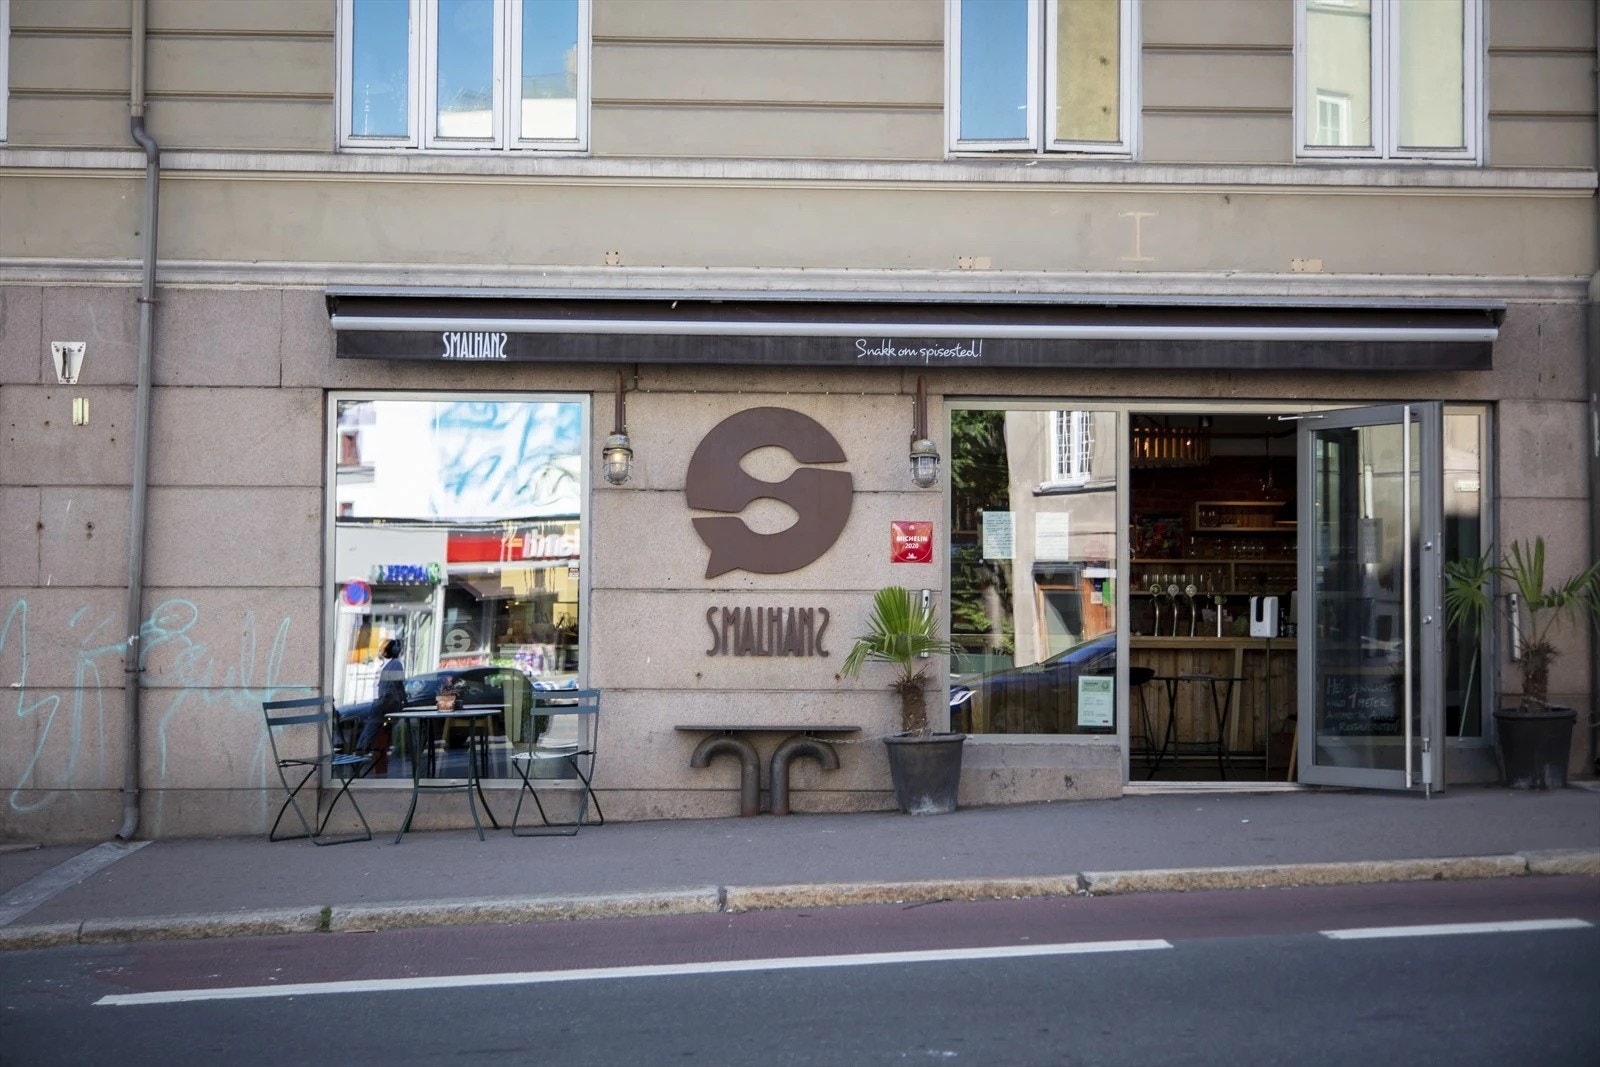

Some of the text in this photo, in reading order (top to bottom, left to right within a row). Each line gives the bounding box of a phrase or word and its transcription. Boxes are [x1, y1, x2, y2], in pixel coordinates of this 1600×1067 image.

[442, 332, 508, 358] SMALHANS
[855, 339, 982, 364] Snakk om spisested!
[706, 606, 830, 657] SMALHANS
